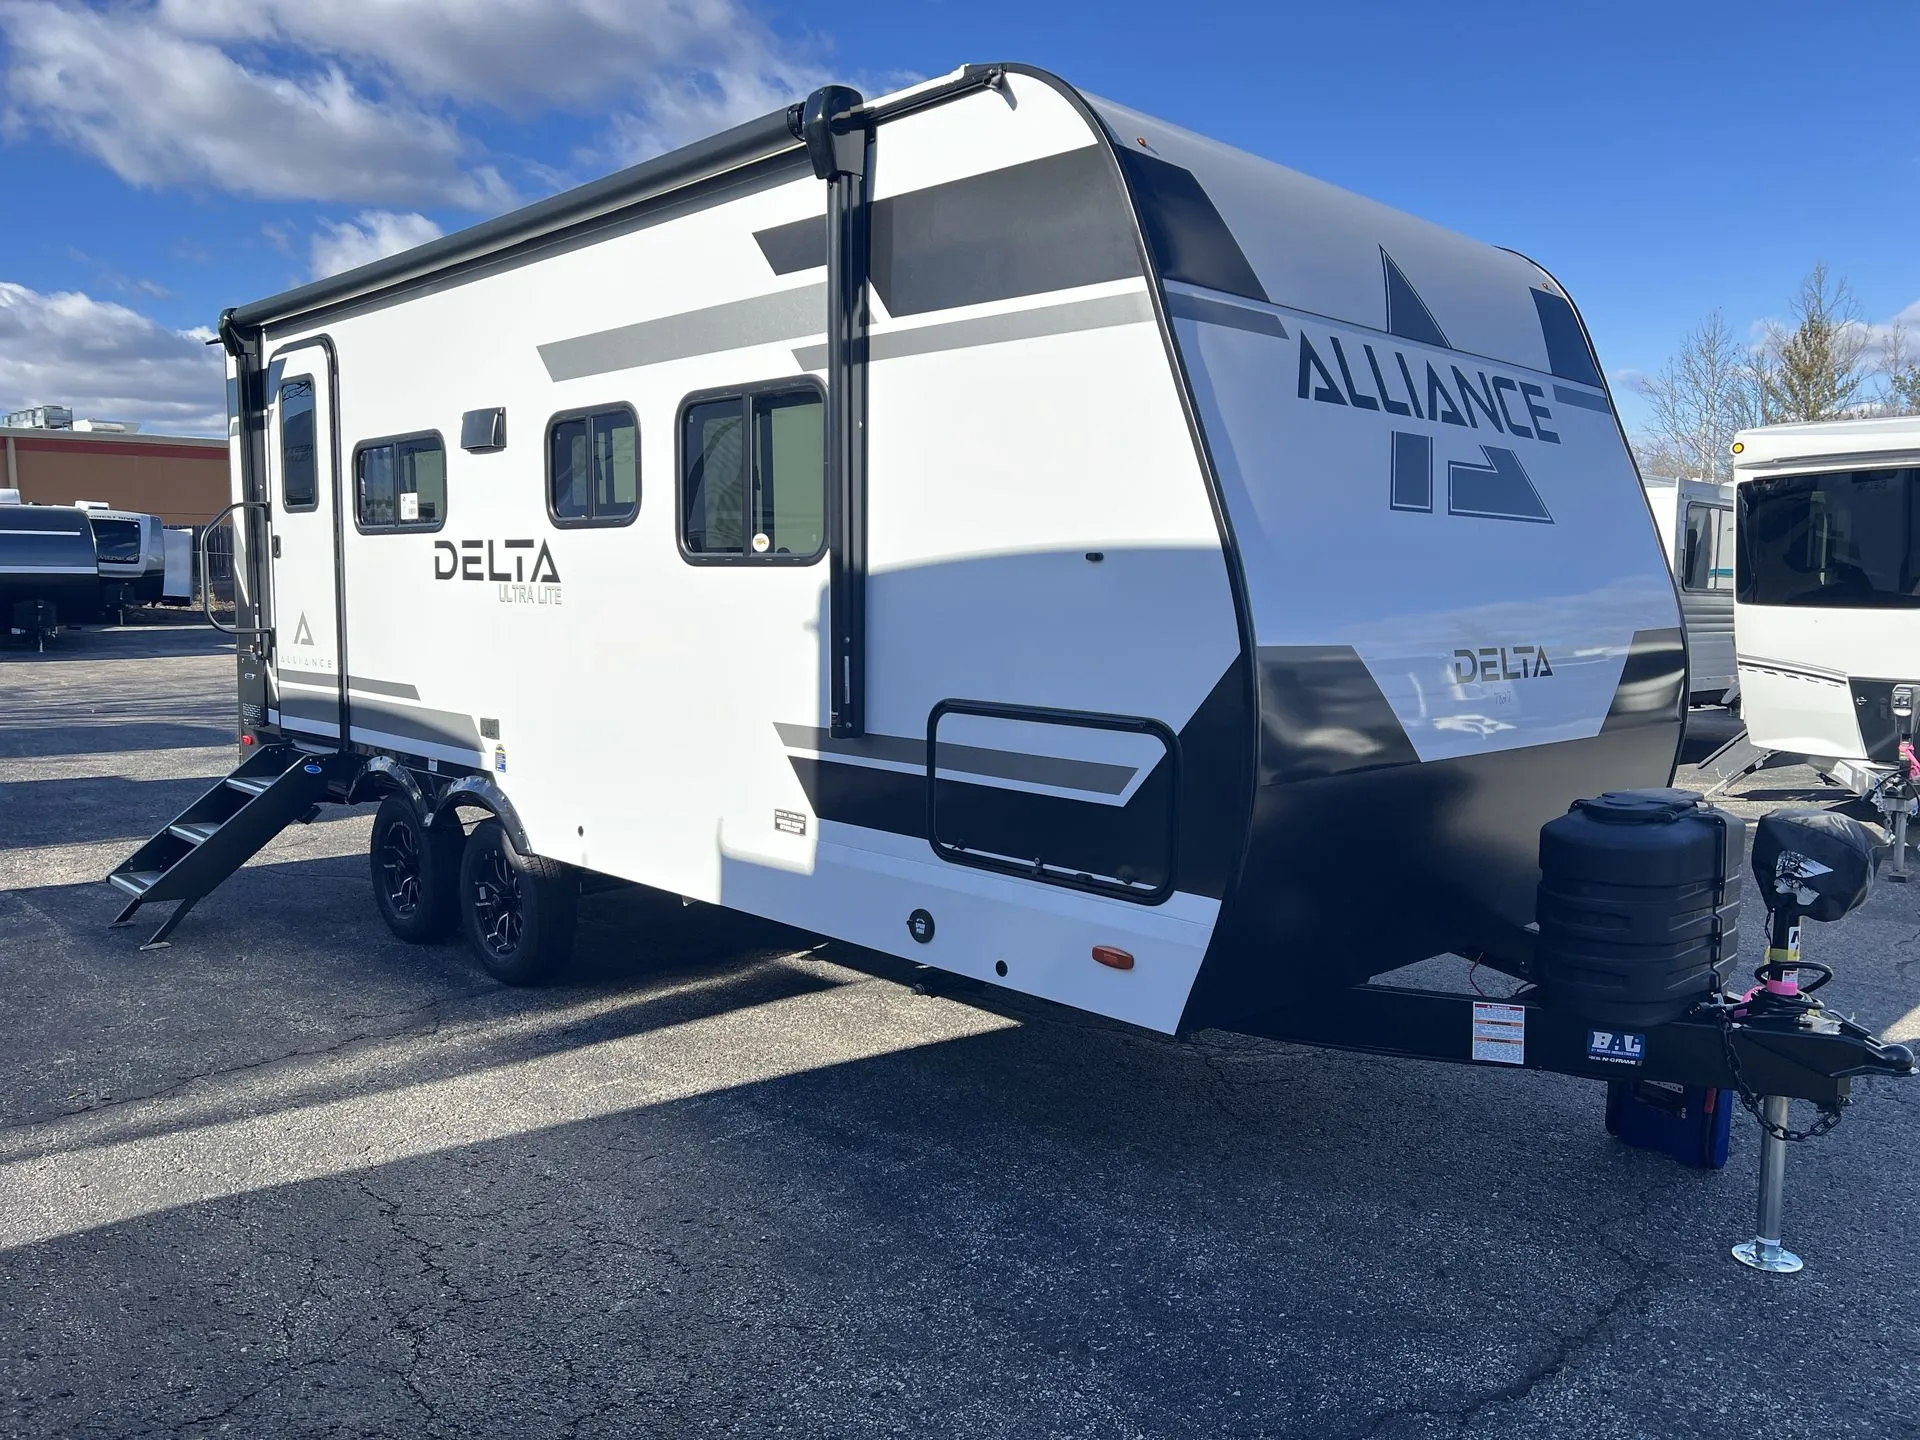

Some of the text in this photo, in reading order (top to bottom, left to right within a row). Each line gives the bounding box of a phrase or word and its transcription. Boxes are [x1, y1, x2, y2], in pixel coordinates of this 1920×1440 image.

[1297, 329, 1562, 445] ALLIANCE
[434, 538, 561, 583] DELTA
[499, 583, 562, 605] ULTRA LITE
[280, 655, 332, 669] ALLIANCE
[1454, 645, 1553, 684] DELTA
[1591, 1031, 1641, 1053] BAL
